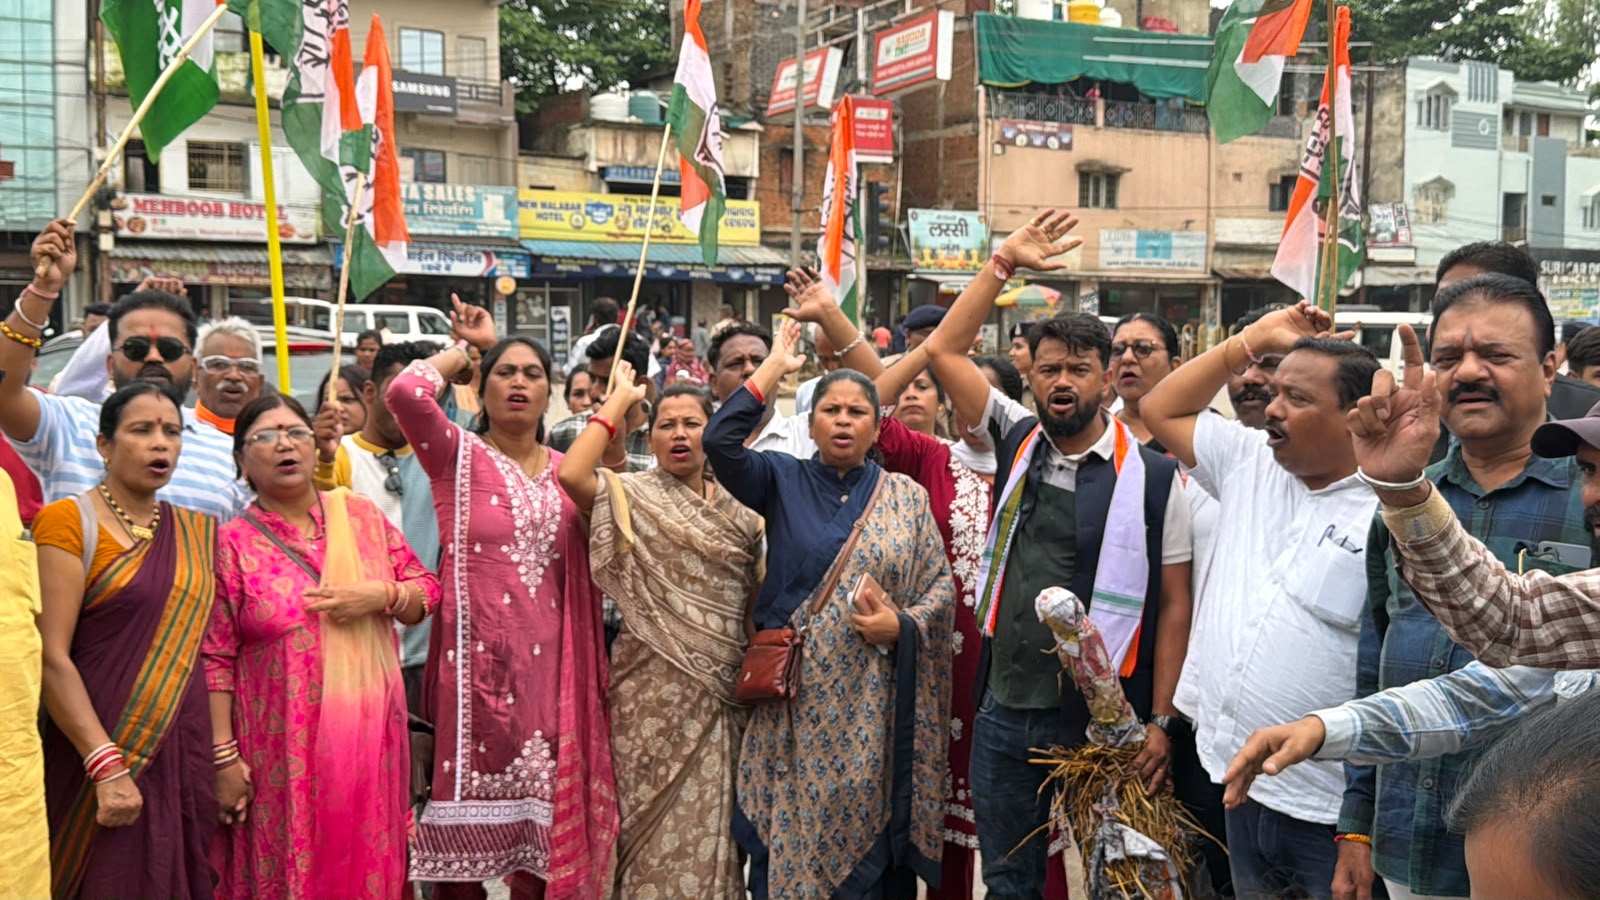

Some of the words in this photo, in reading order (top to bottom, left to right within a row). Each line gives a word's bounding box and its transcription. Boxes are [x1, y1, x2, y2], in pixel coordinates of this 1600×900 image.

[391, 80, 451, 98] SAMSUNG
[423, 184, 475, 201] SALES
[134, 199, 223, 217] MEHBOOB
[229, 201, 288, 219] HOTL
[536, 212, 565, 221] HOTEL
[929, 217, 969, 237] लस्सी
